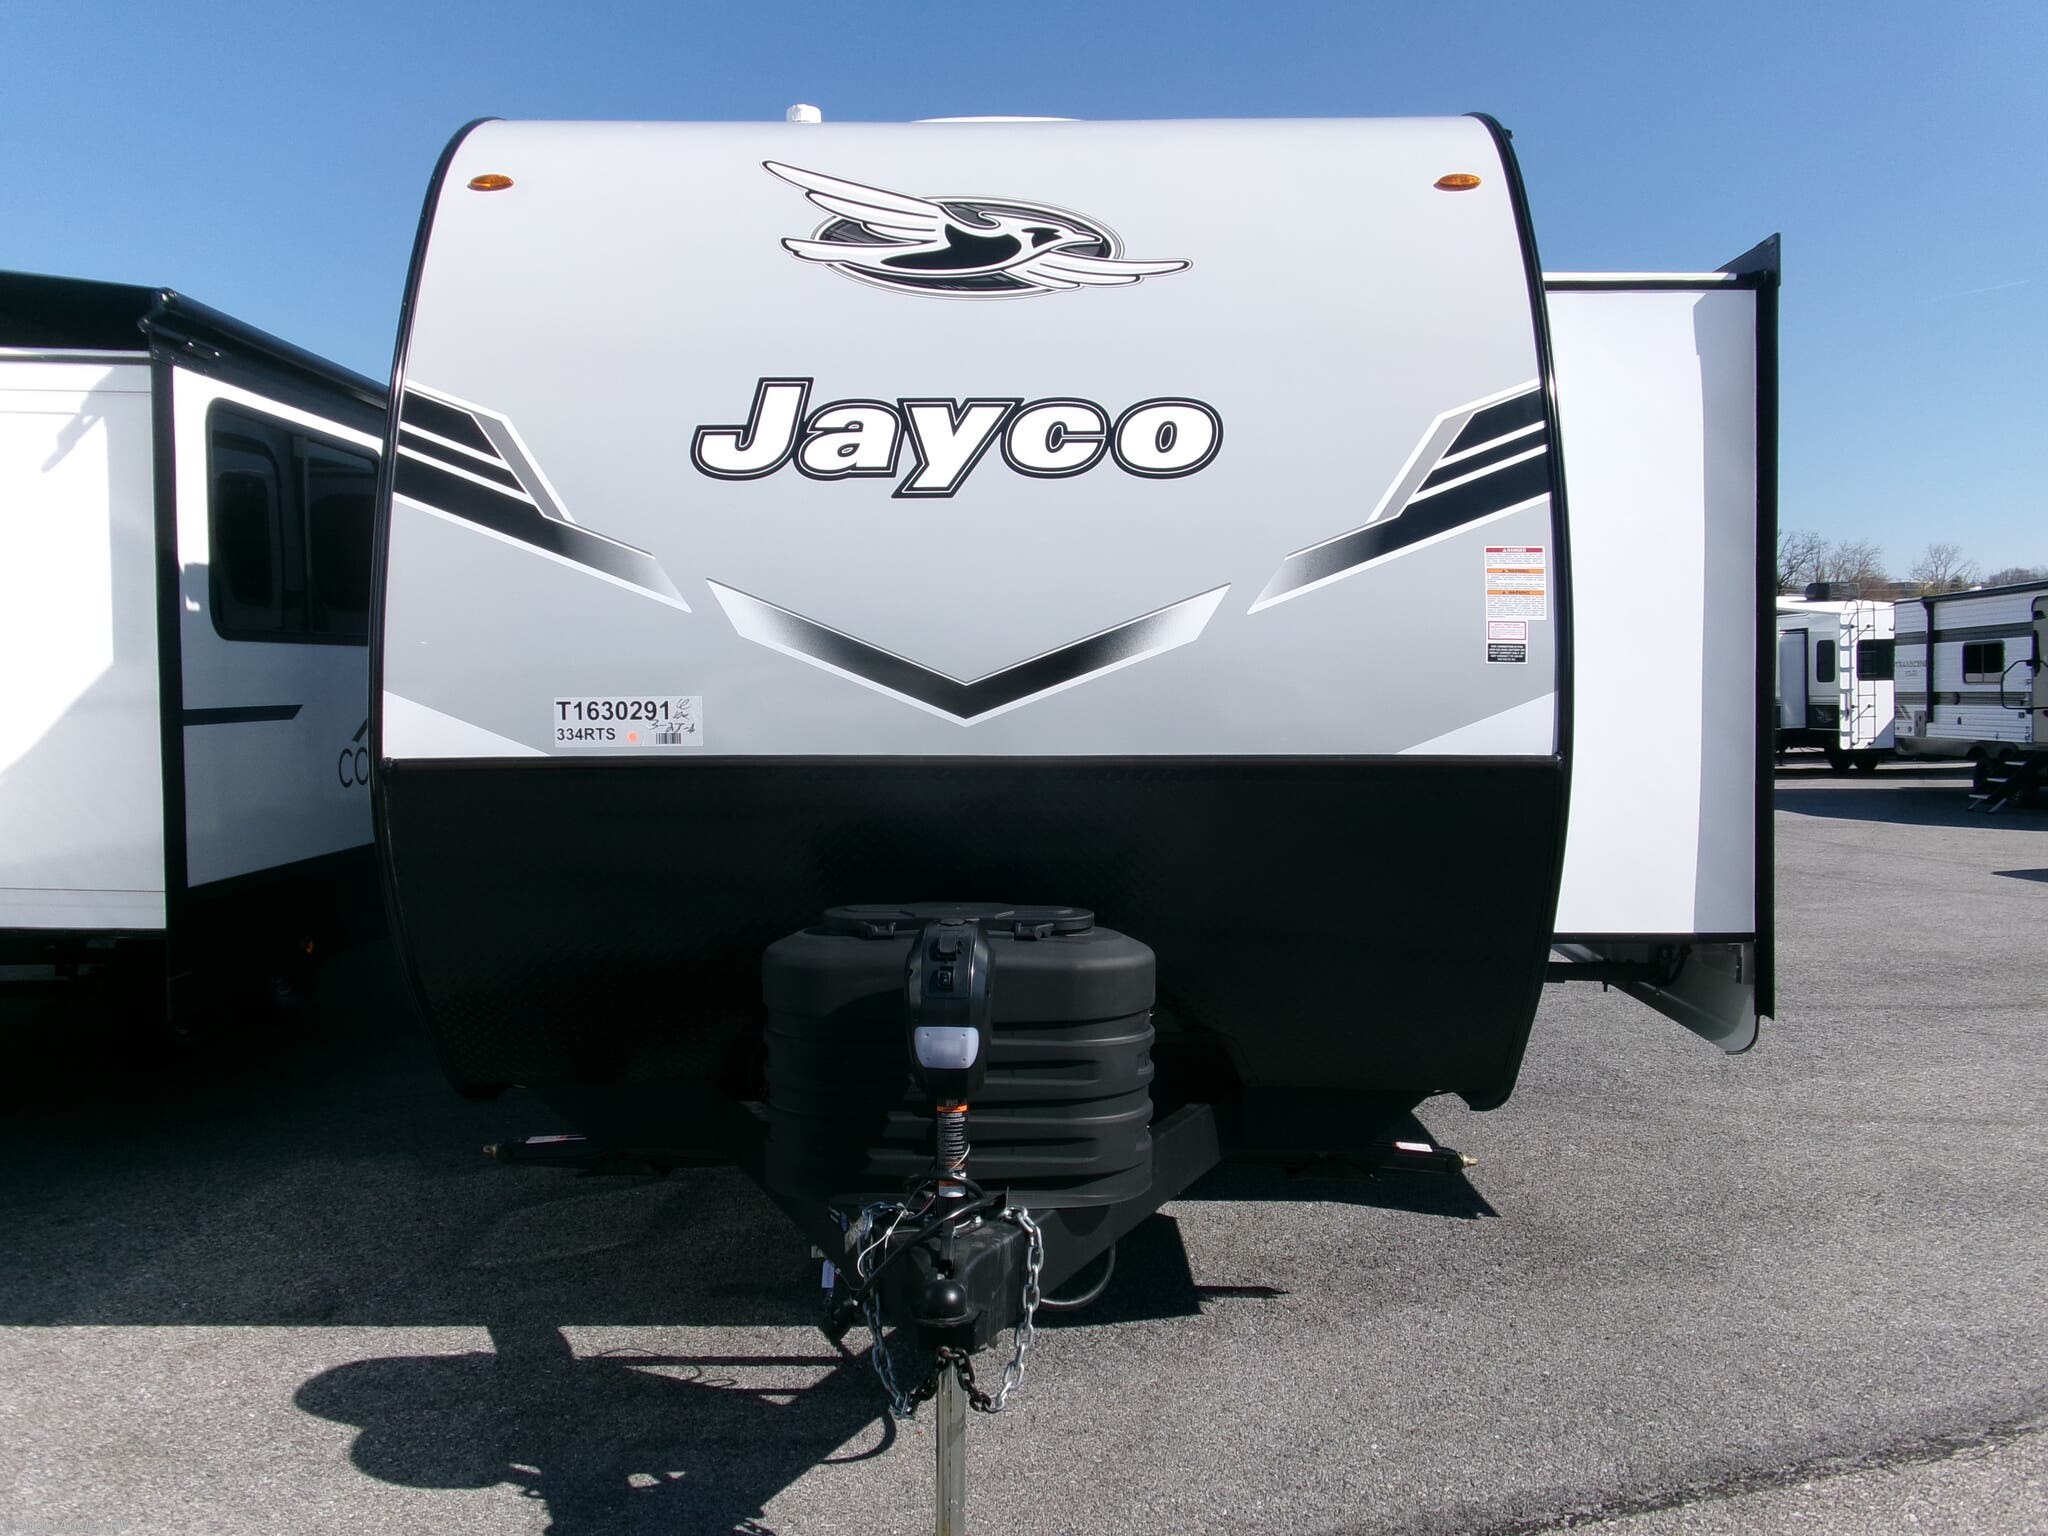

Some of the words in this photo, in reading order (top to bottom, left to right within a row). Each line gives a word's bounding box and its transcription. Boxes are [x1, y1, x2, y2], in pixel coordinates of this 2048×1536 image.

[690, 376, 1225, 499] Jayco
[556, 700, 670, 721] T1630291
[556, 728, 616, 741] 334RTS
